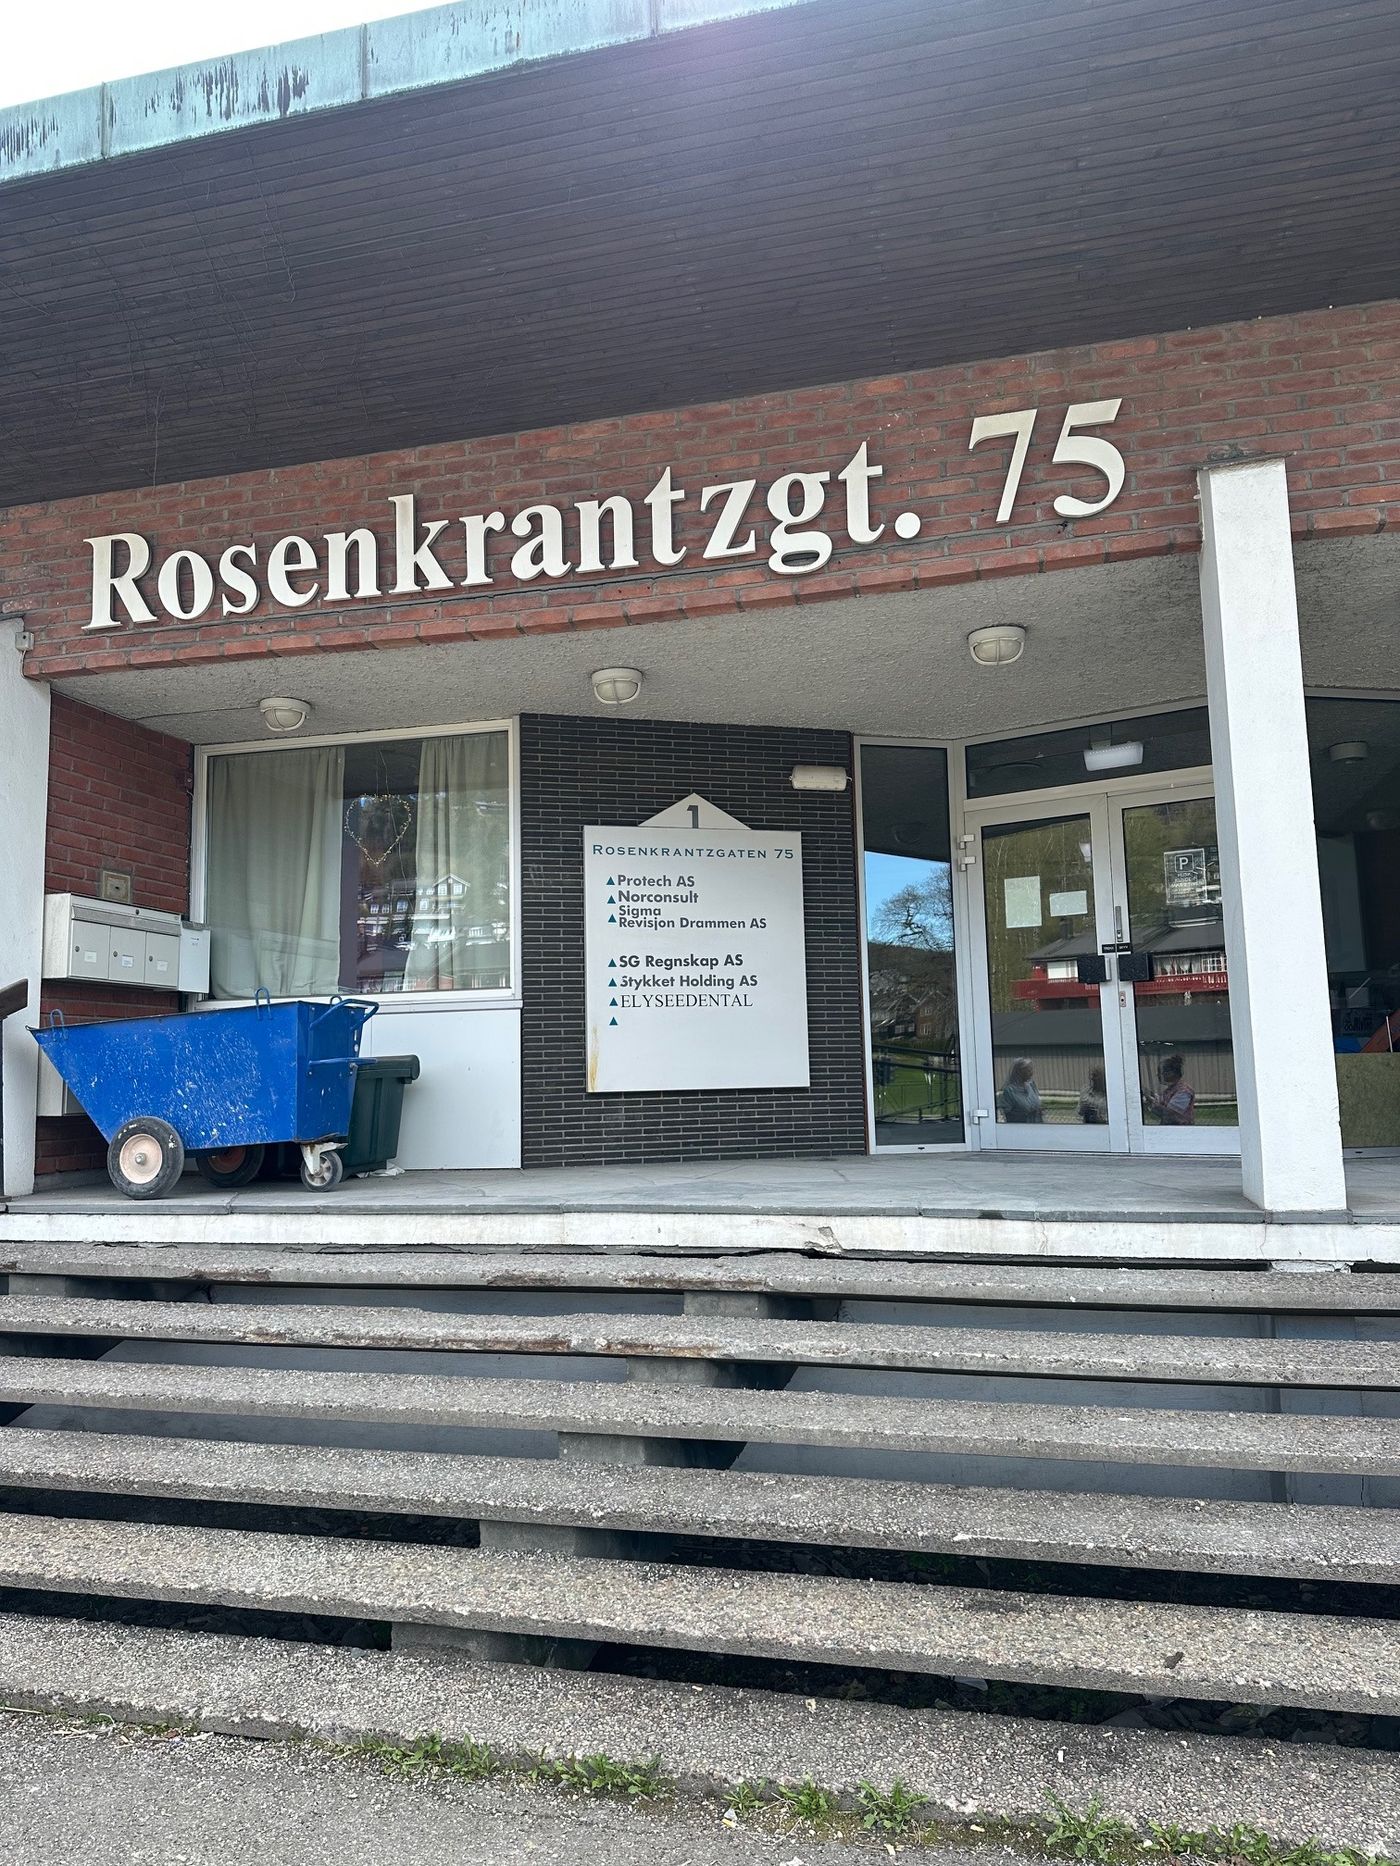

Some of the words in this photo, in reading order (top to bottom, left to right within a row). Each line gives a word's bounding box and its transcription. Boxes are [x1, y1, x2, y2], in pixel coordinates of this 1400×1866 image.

[82, 440, 923, 632] Rosenkrantzgt.
[968, 398, 1126, 522] 75
[686, 804, 700, 829] 1
[592, 844, 767, 859] ROSENKRANTZGATEN
[774, 848, 794, 859] 75
[1179, 856, 1189, 870] P
[617, 874, 672, 888] Protech
[676, 875, 695, 887] AS
[618, 890, 699, 904] Norconsult
[618, 904, 662, 919] Sigma
[618, 917, 675, 931] Revisjon
[679, 918, 746, 929] Drammen
[749, 917, 767, 929] AS
[619, 955, 640, 968] SG
[645, 953, 719, 970] Regnskap
[723, 954, 744, 966] AS
[620, 974, 675, 990] Stykket
[679, 974, 735, 989] Holding
[739, 974, 758, 987] AS
[620, 993, 753, 1008] ELYSEEDENTAL
